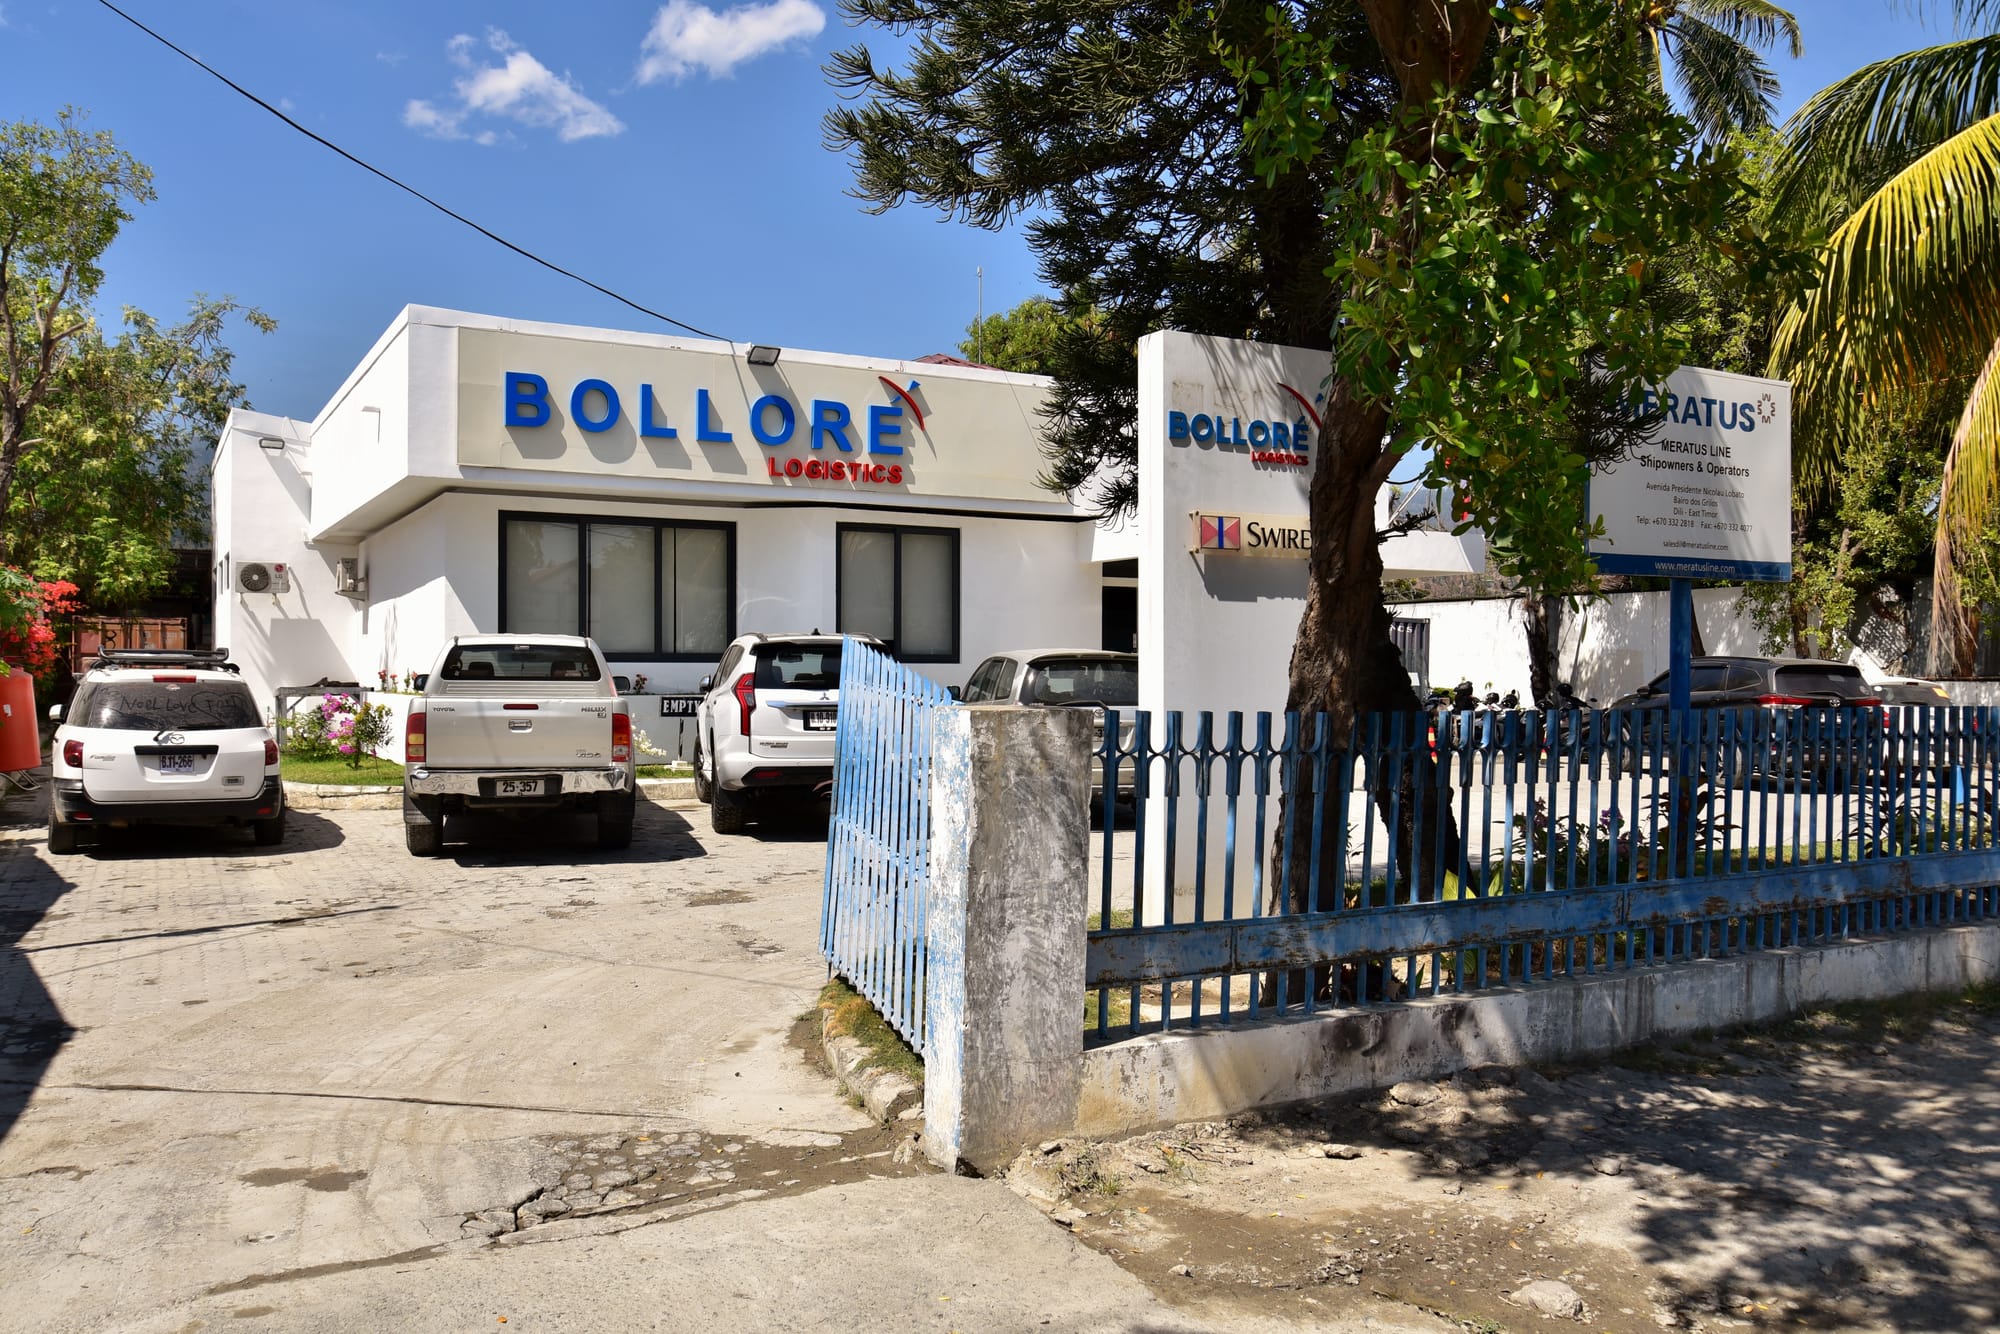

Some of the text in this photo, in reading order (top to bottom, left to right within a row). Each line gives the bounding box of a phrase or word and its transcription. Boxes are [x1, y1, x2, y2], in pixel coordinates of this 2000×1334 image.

[1617, 388, 1756, 432] ERATUS
[1168, 410, 1309, 451] BOLLORÉ
[1661, 439, 1732, 459] MERATUS LINE
[1251, 451, 1309, 466] LOGISTICS
[1640, 455, 1750, 478] Shipowners & Operators
[768, 456, 903, 484] LOGISTICS
[1646, 482, 1745, 499] Avenida Presidente Nicolau Lobato
[1690, 498, 1701, 506] dos
[1673, 507, 1684, 516] Dili
[1688, 508, 1701, 517] East
[1701, 509, 1718, 518] Timor
[1652, 517, 1667, 526] +670
[1668, 518, 1679, 527] 332
[1713, 522, 1727, 531] +670
[1728, 523, 1739, 532] 332
[1654, 561, 1736, 574] www.meratusline.com
[663, 699, 701, 713] EMPTY
